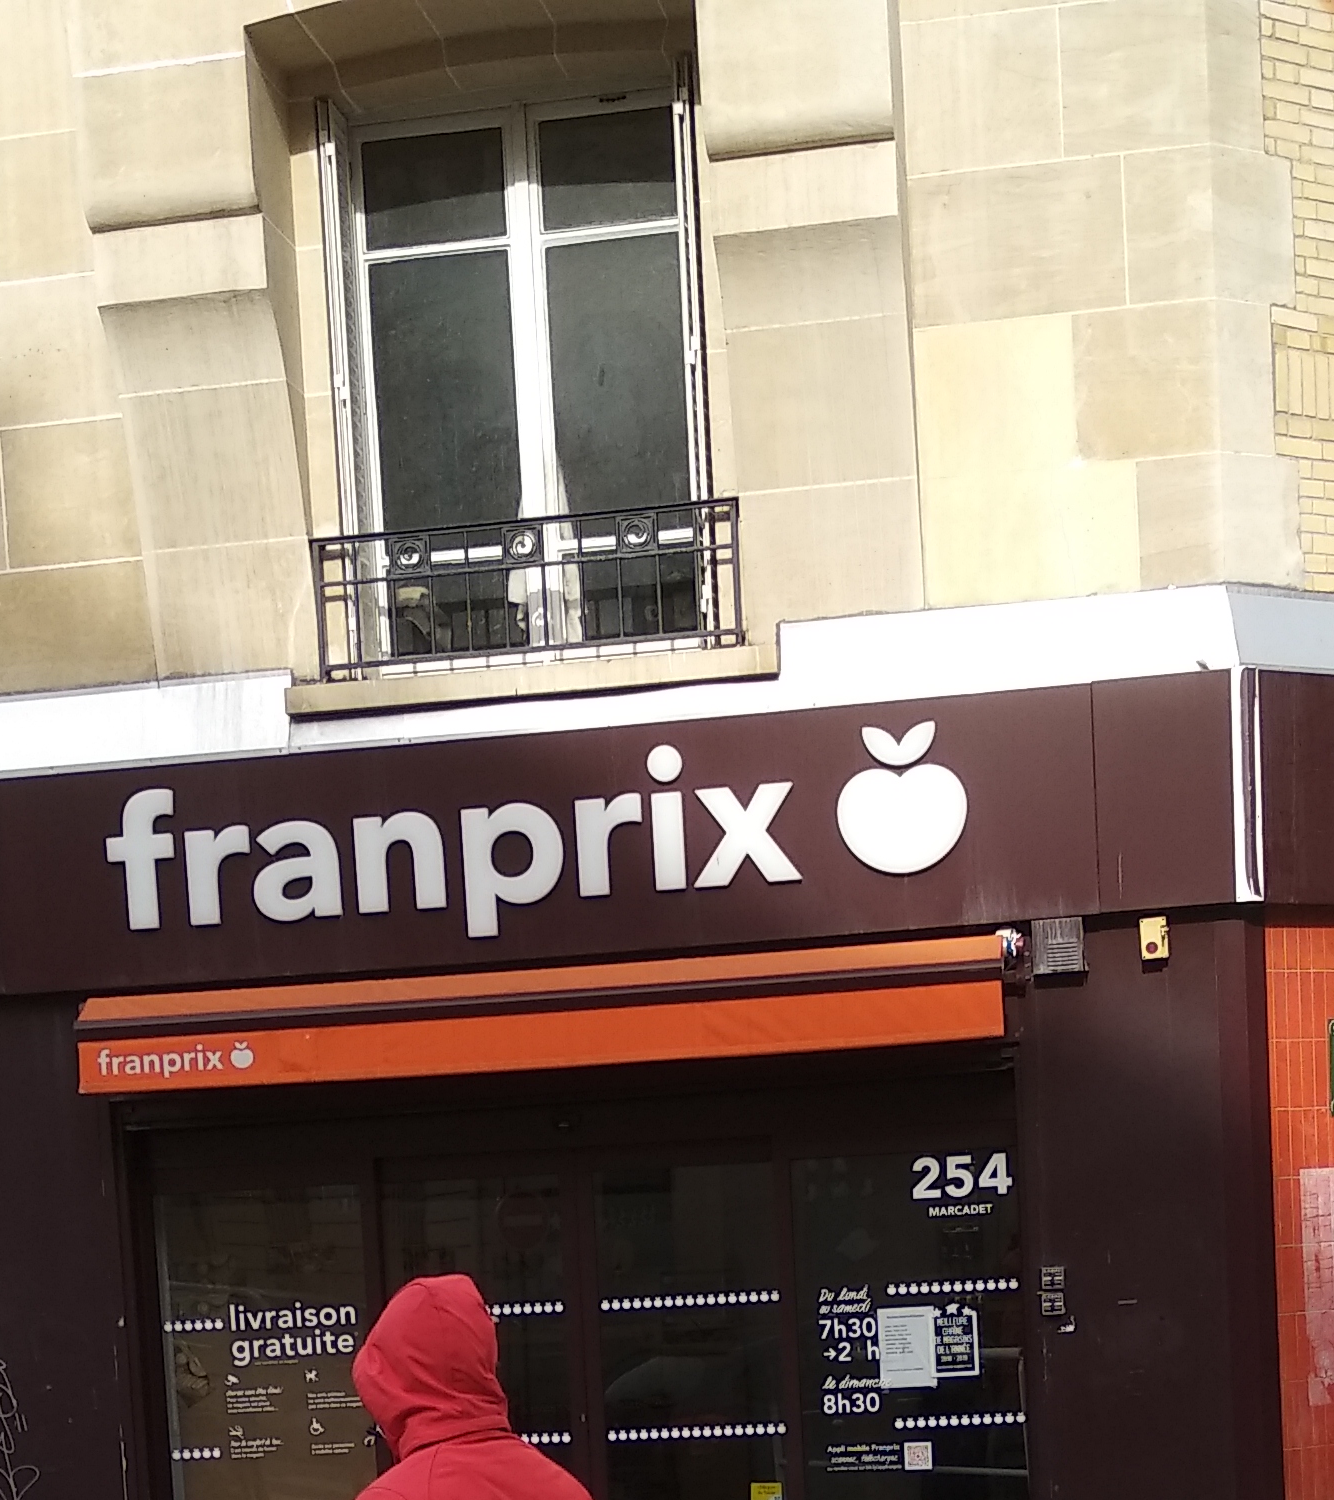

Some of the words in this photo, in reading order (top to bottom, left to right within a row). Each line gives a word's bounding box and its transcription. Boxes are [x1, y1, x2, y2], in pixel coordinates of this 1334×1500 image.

[106, 744, 804, 938] franprix
[97, 1043, 224, 1078] franprix
[911, 1152, 1013, 1200] 254
[928, 1203, 993, 1217] MARCADET
[819, 1288, 835, 1302] Du
[837, 1284, 869, 1301] lundi
[819, 1304, 830, 1314] au
[832, 1298, 871, 1314] samedi
[229, 1301, 357, 1331] livraison
[937, 1316, 968, 1327] MEILLEURE
[818, 1318, 876, 1339] 7h30
[231, 1329, 355, 1367] gratuite
[943, 1335, 973, 1344] MAGASINS
[839, 1374, 893, 1389] dimanche
[823, 1392, 880, 1414] 8h30
[827, 1445, 846, 1454] Appli
[847, 1444, 870, 1452] mobile
[871, 1443, 901, 1452] Franprix
